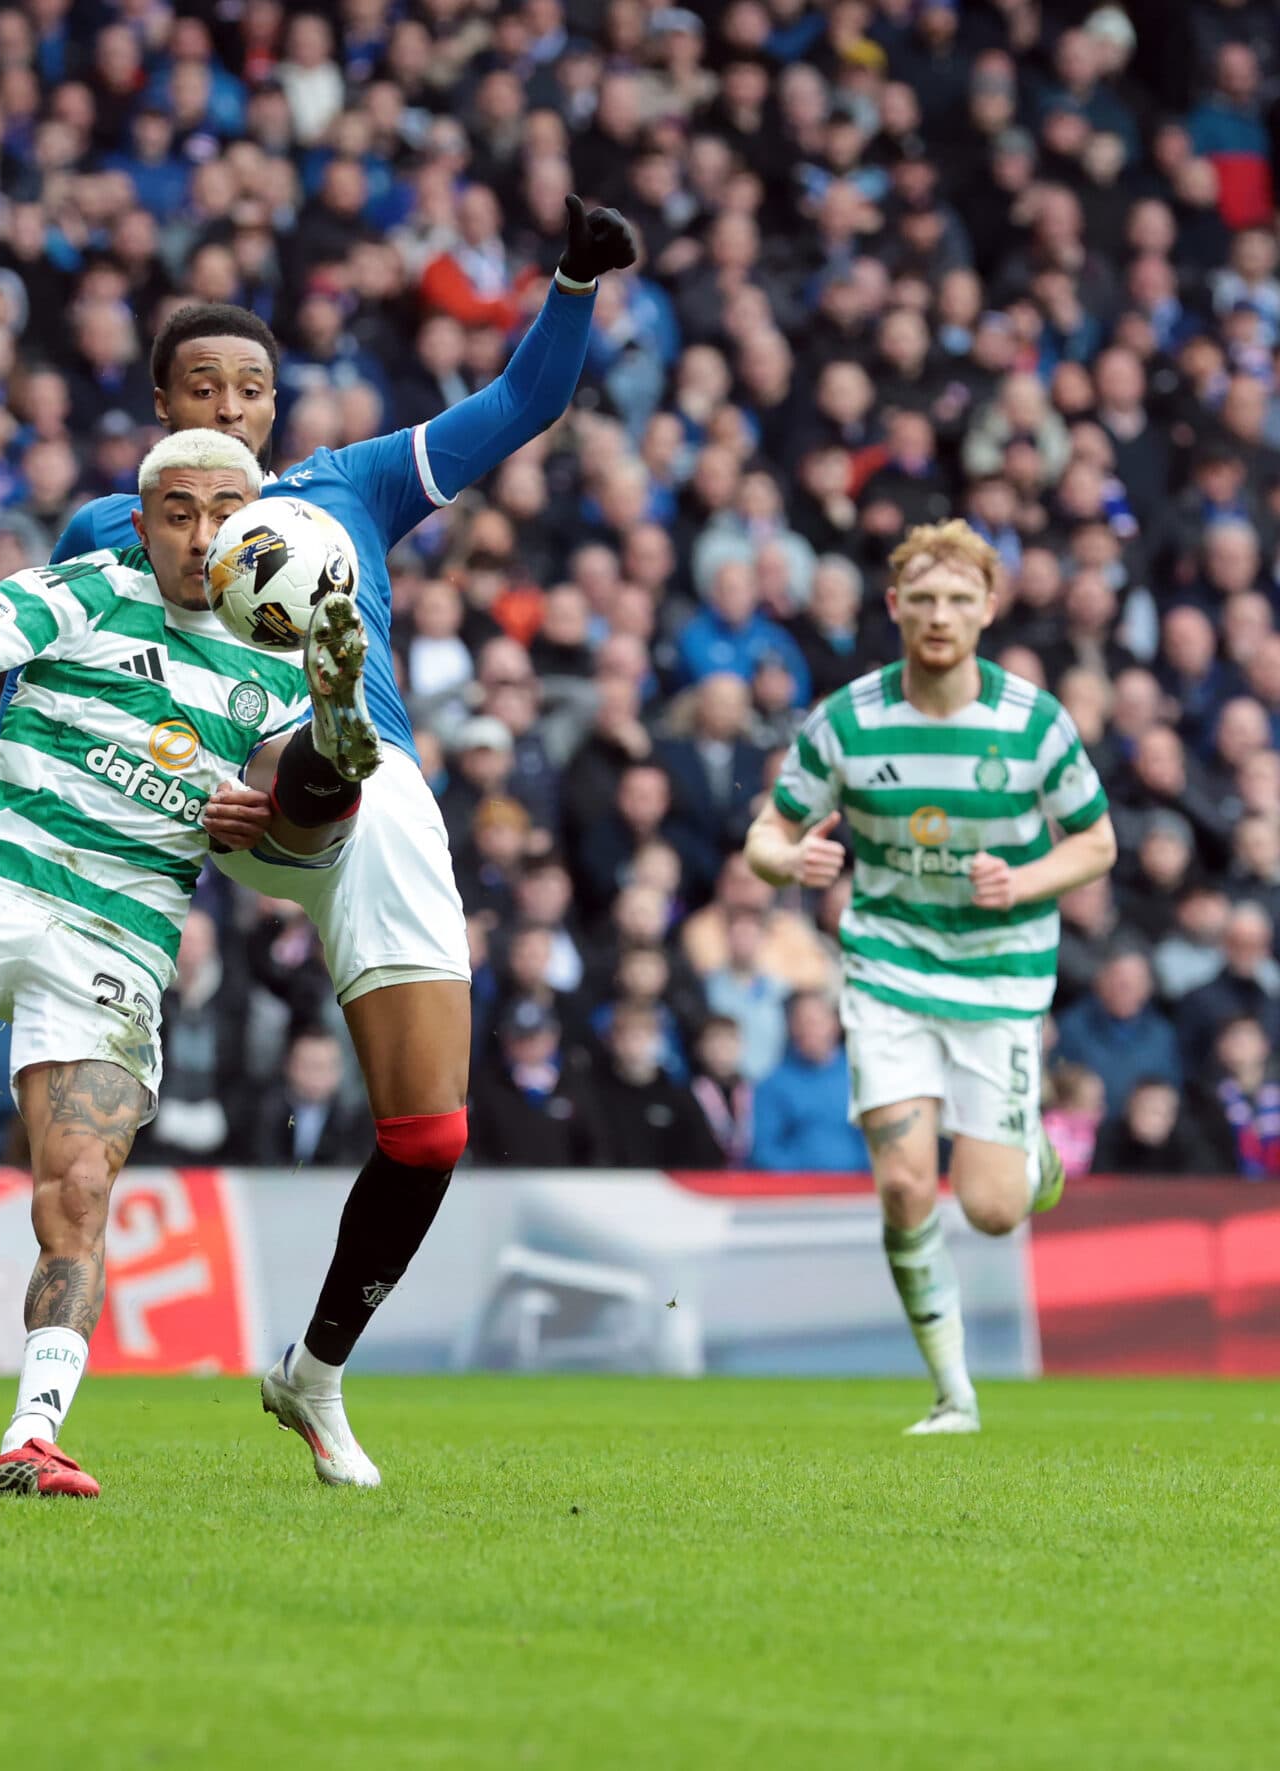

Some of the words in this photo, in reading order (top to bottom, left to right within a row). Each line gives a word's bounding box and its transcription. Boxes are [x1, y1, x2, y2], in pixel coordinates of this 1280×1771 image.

[86, 744, 207, 828] dafabe
[884, 846, 975, 876] dafabe
[1009, 1045, 1031, 1097] 5
[35, 1347, 81, 1371] CELTIC
